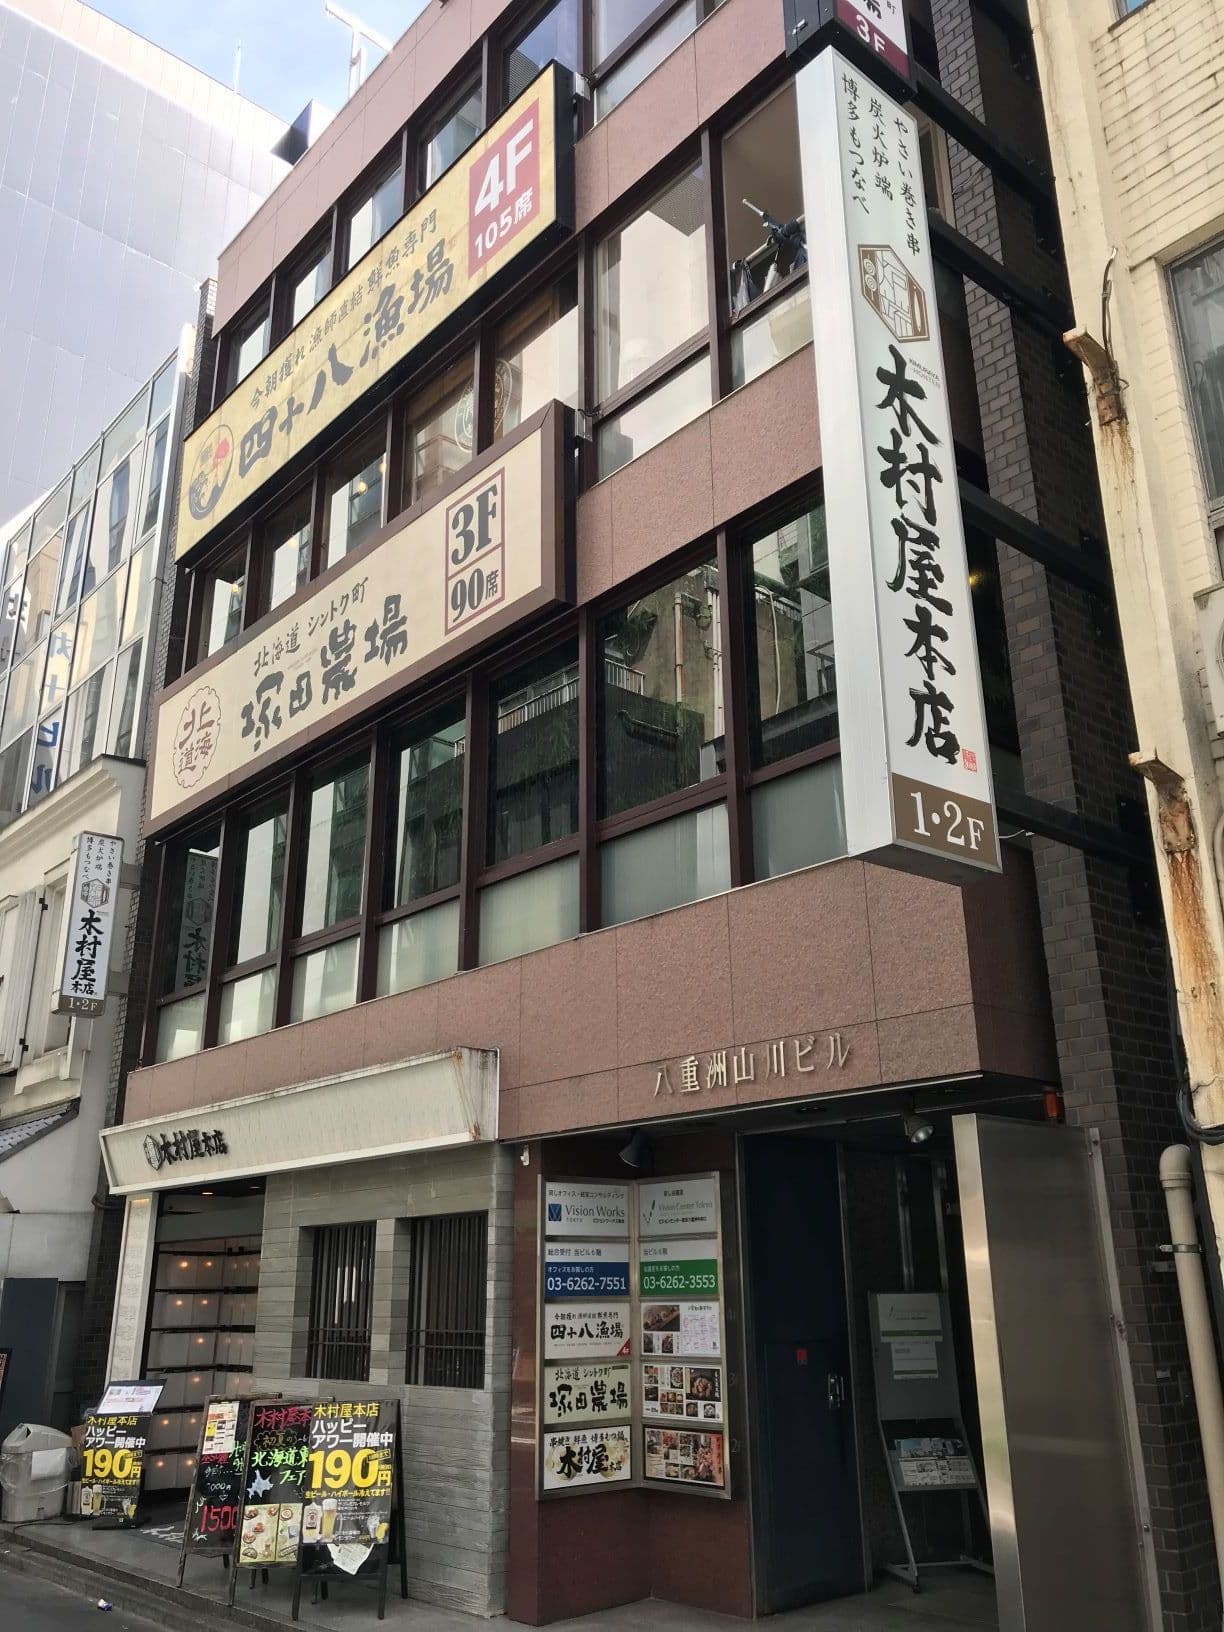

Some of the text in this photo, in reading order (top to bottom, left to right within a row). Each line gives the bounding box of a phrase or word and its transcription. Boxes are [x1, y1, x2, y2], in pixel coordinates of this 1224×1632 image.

[856, 14, 886, 53] 3F
[841, 72, 870, 215] 博多もつなべ
[869, 97, 894, 202] 炭火炉端
[475, 118, 534, 216] 4F
[894, 117, 921, 256] やさい巻き串
[475, 186, 533, 258] 105席
[238, 238, 454, 479] 四十八漁場
[451, 485, 498, 565] 3F
[875, 344, 960, 765] 木村屋本店
[451, 567, 499, 623] 90席
[253, 577, 369, 678] 北海道 シントク町
[240, 594, 409, 752] 塚田農場
[654, 1032, 850, 1098] 八重洲山川ビル
[565, 1204, 625, 1218] Vision Works
[547, 1276, 627, 1291] 03-6262-7551
[643, 1274, 716, 1289] 03-6262-3553
[550, 1320, 624, 1340] 四十八漁場
[555, 1366, 581, 1381] 北海道
[313, 1402, 380, 1419] 木村屋本店
[549, 1380, 628, 1417] 塚田農場
[85, 1425, 127, 1438] ハッピー
[85, 1436, 146, 1449] アワー開催中
[311, 1419, 367, 1435] ハッピー
[311, 1432, 393, 1449] アワー開催中
[556, 1444, 609, 1479] 木村屋
